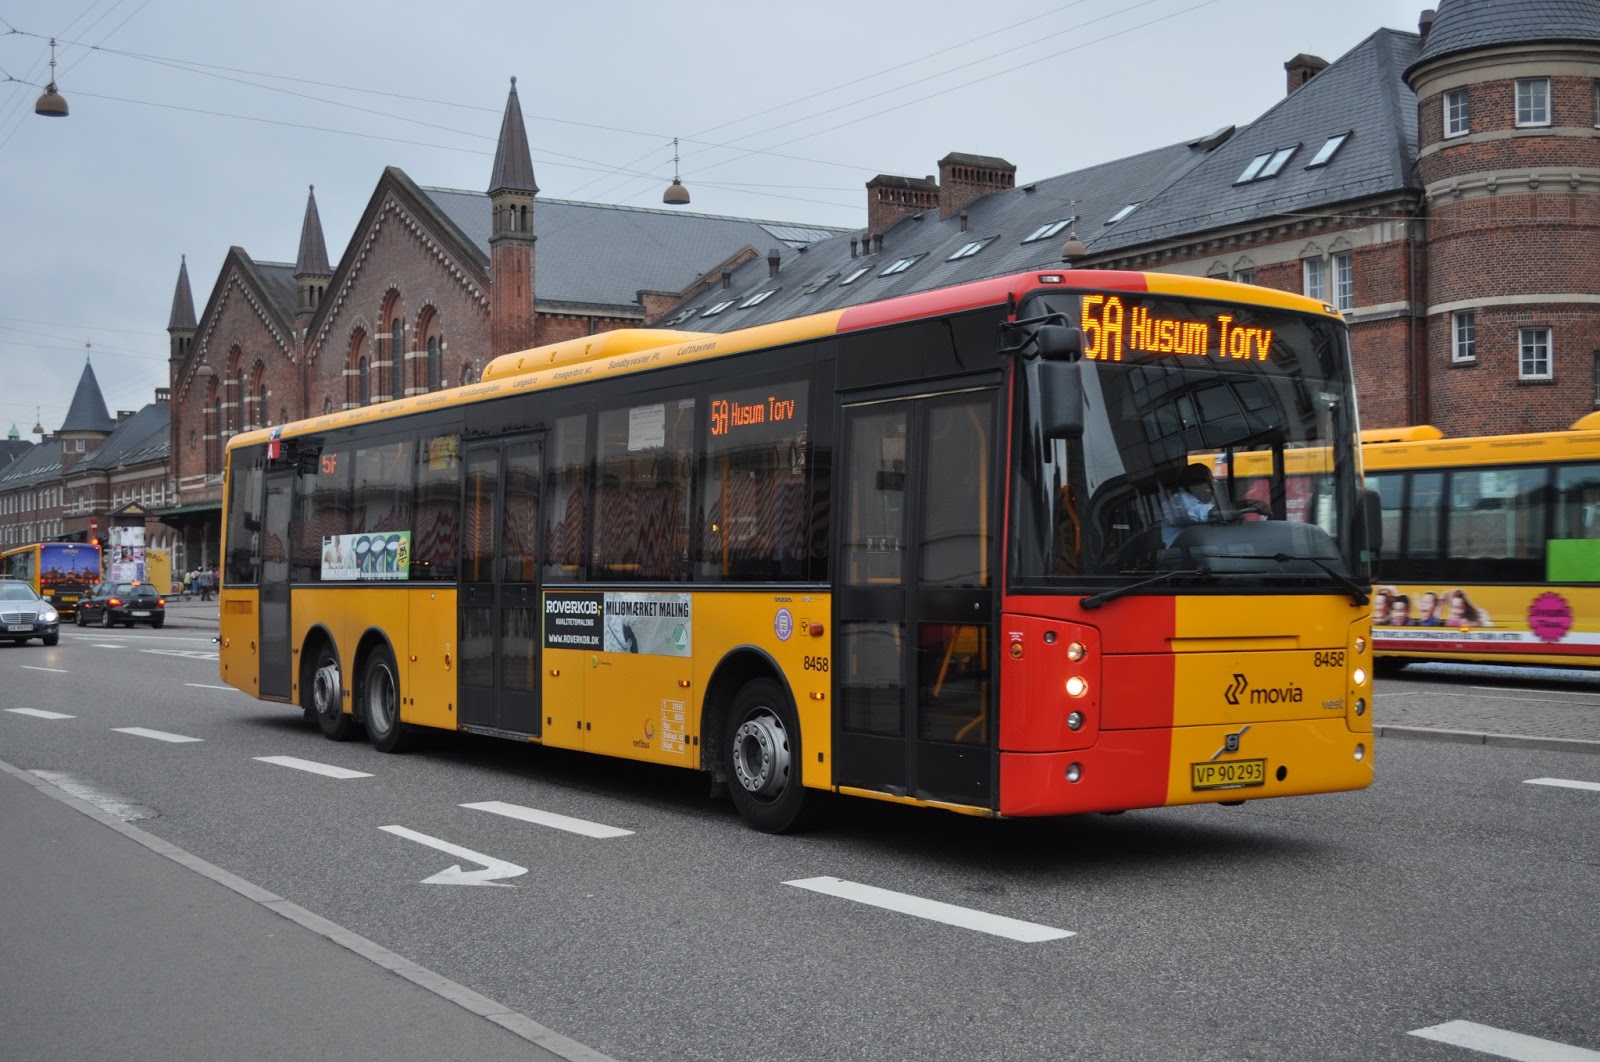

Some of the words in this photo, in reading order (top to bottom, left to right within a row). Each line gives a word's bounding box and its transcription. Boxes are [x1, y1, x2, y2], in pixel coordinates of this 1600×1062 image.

[1081, 295, 1123, 361] 5A
[1130, 306, 1208, 356] Husum
[1218, 314, 1272, 361] Torv
[677, 342, 717, 356] Lufthavnen
[711, 400, 728, 435] 5A
[731, 402, 765, 426] Husum
[768, 396, 794, 421] Torv
[605, 601, 657, 617] MILJØMÆRKET
[659, 602, 689, 618] MALING
[803, 655, 829, 672] 8458
[1313, 651, 1344, 668] 8458
[1249, 682, 1303, 705] movia
[1196, 767, 1215, 783] VP
[1218, 765, 1234, 781] 90
[1237, 763, 1262, 780] 293
